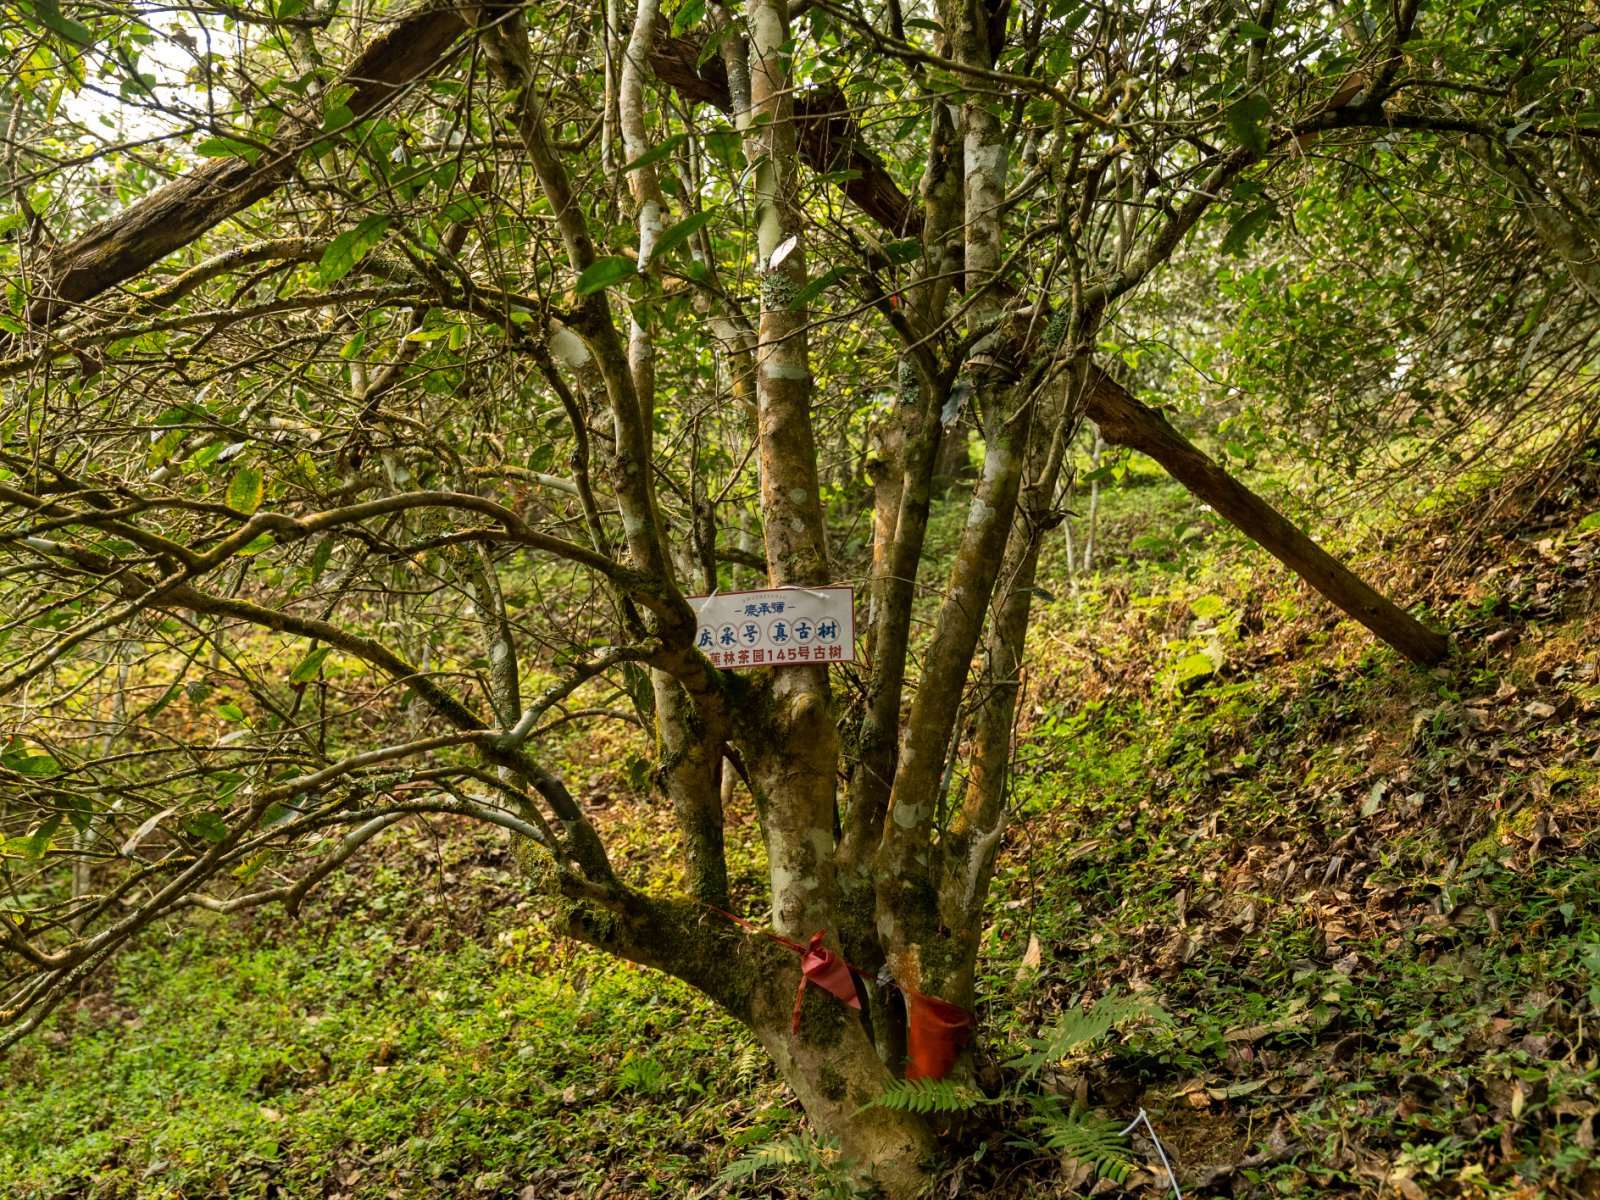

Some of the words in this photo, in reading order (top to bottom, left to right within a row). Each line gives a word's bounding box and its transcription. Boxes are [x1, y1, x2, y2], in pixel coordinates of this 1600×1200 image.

[698, 624, 758, 647] 庆承号
[773, 621, 837, 642] 真古树
